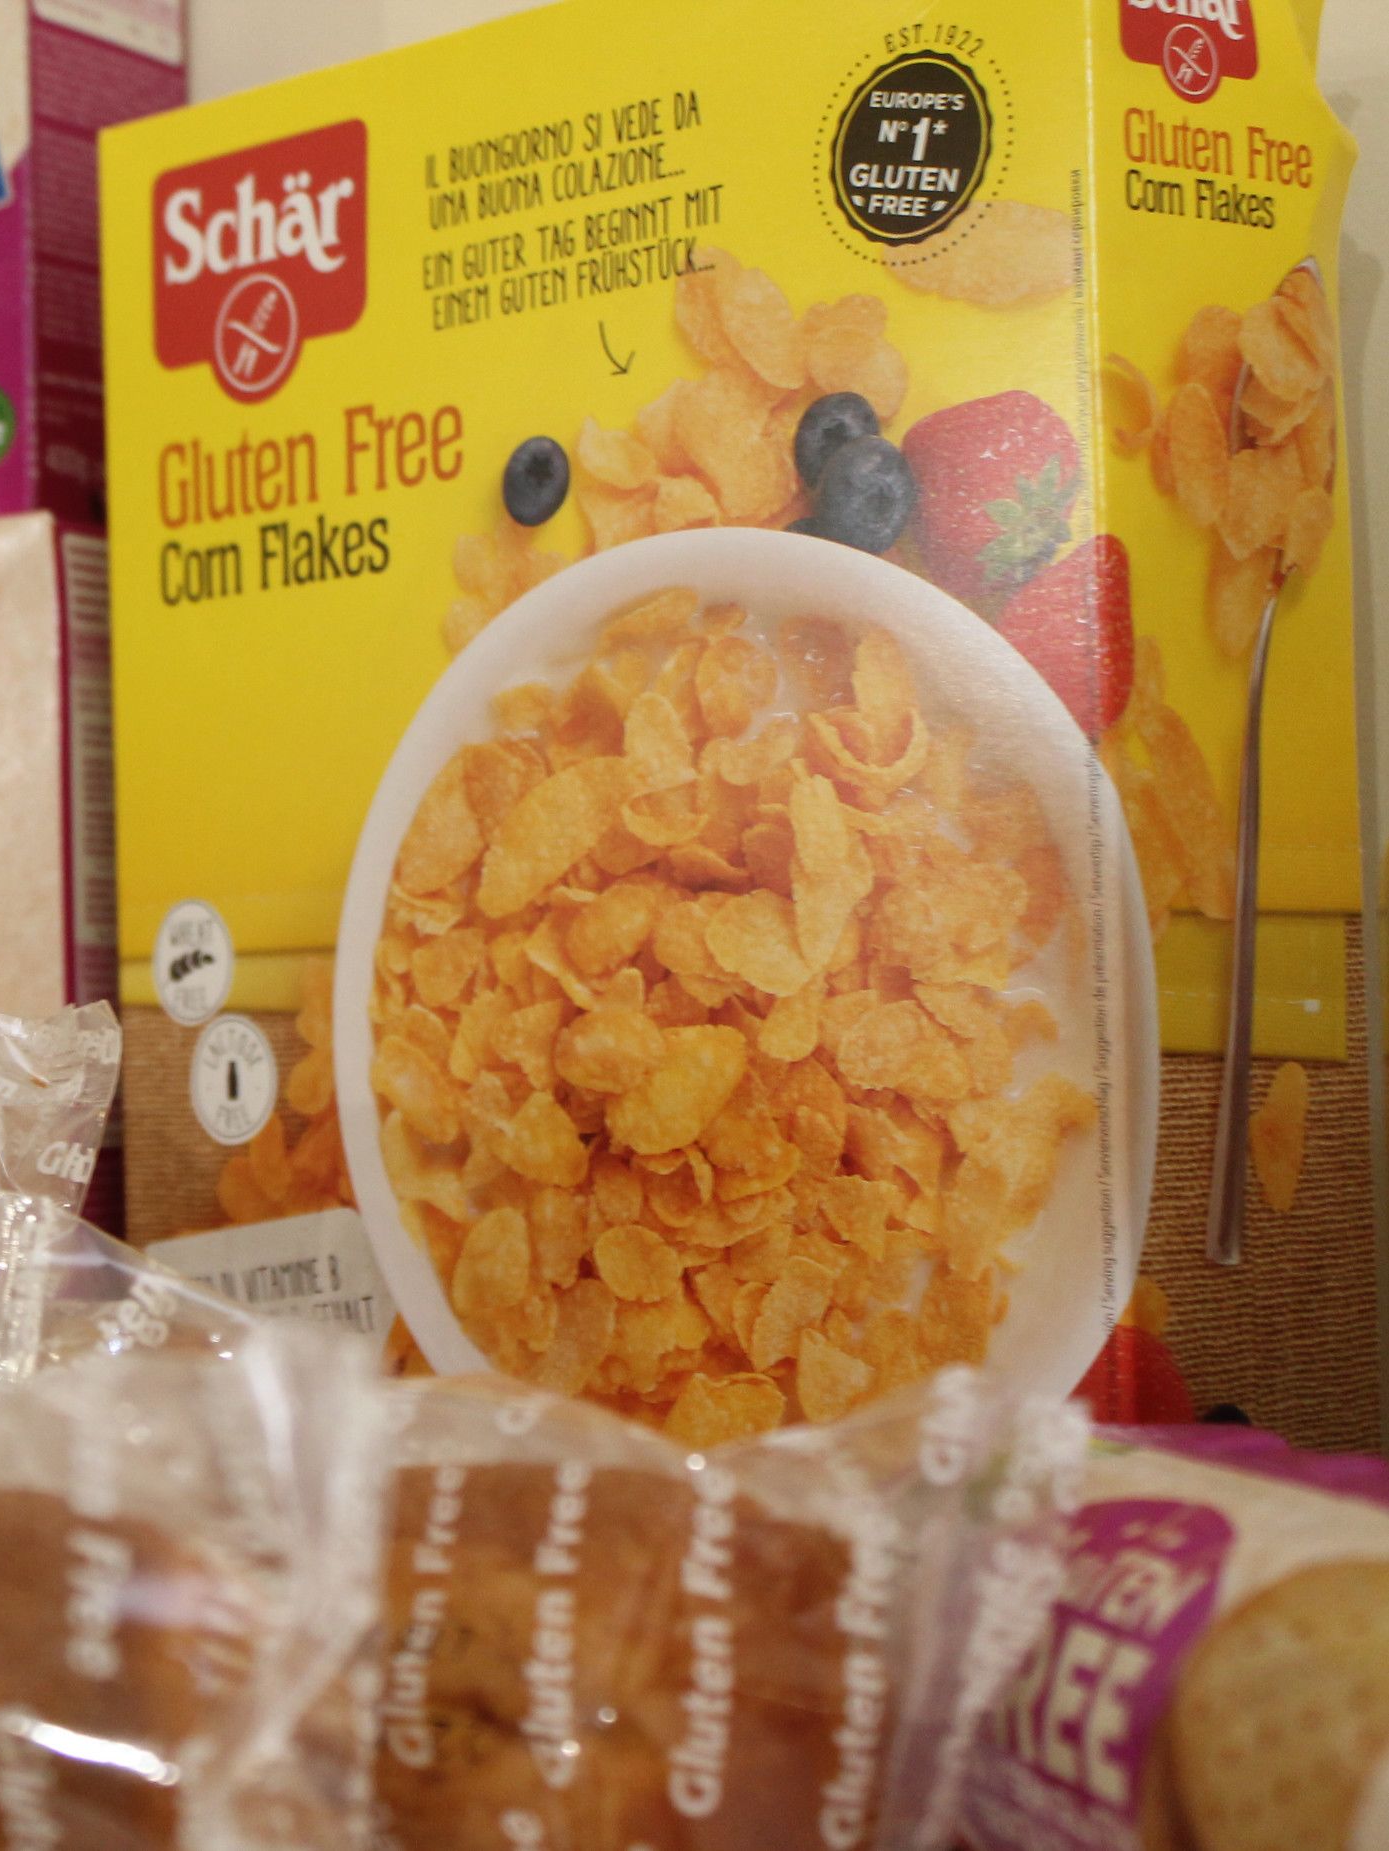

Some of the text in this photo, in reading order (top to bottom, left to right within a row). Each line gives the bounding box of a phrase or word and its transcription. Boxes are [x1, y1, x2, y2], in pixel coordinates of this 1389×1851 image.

[425, 90, 703, 189] IL BUONGIORNO SI VEDE DA
[868, 90, 966, 111] EUROPE'S
[848, 162, 960, 193] GLUTEN
[1123, 107, 1314, 189] Gluten Free
[163, 168, 356, 286] Schär
[423, 184, 725, 291] EIN GUTER TAG BEGINNT MIT
[428, 190, 470, 231] UNA
[478, 169, 545, 220] BUONA
[867, 194, 929, 217] FREE
[1125, 169, 1277, 230] Corn Flakes
[433, 282, 495, 332] EINEM
[501, 262, 569, 317] GUTEN
[159, 402, 465, 530] Gluten Free
[159, 514, 391, 606] Corn Flakes
[668, 1614, 734, 1818] Gluten
